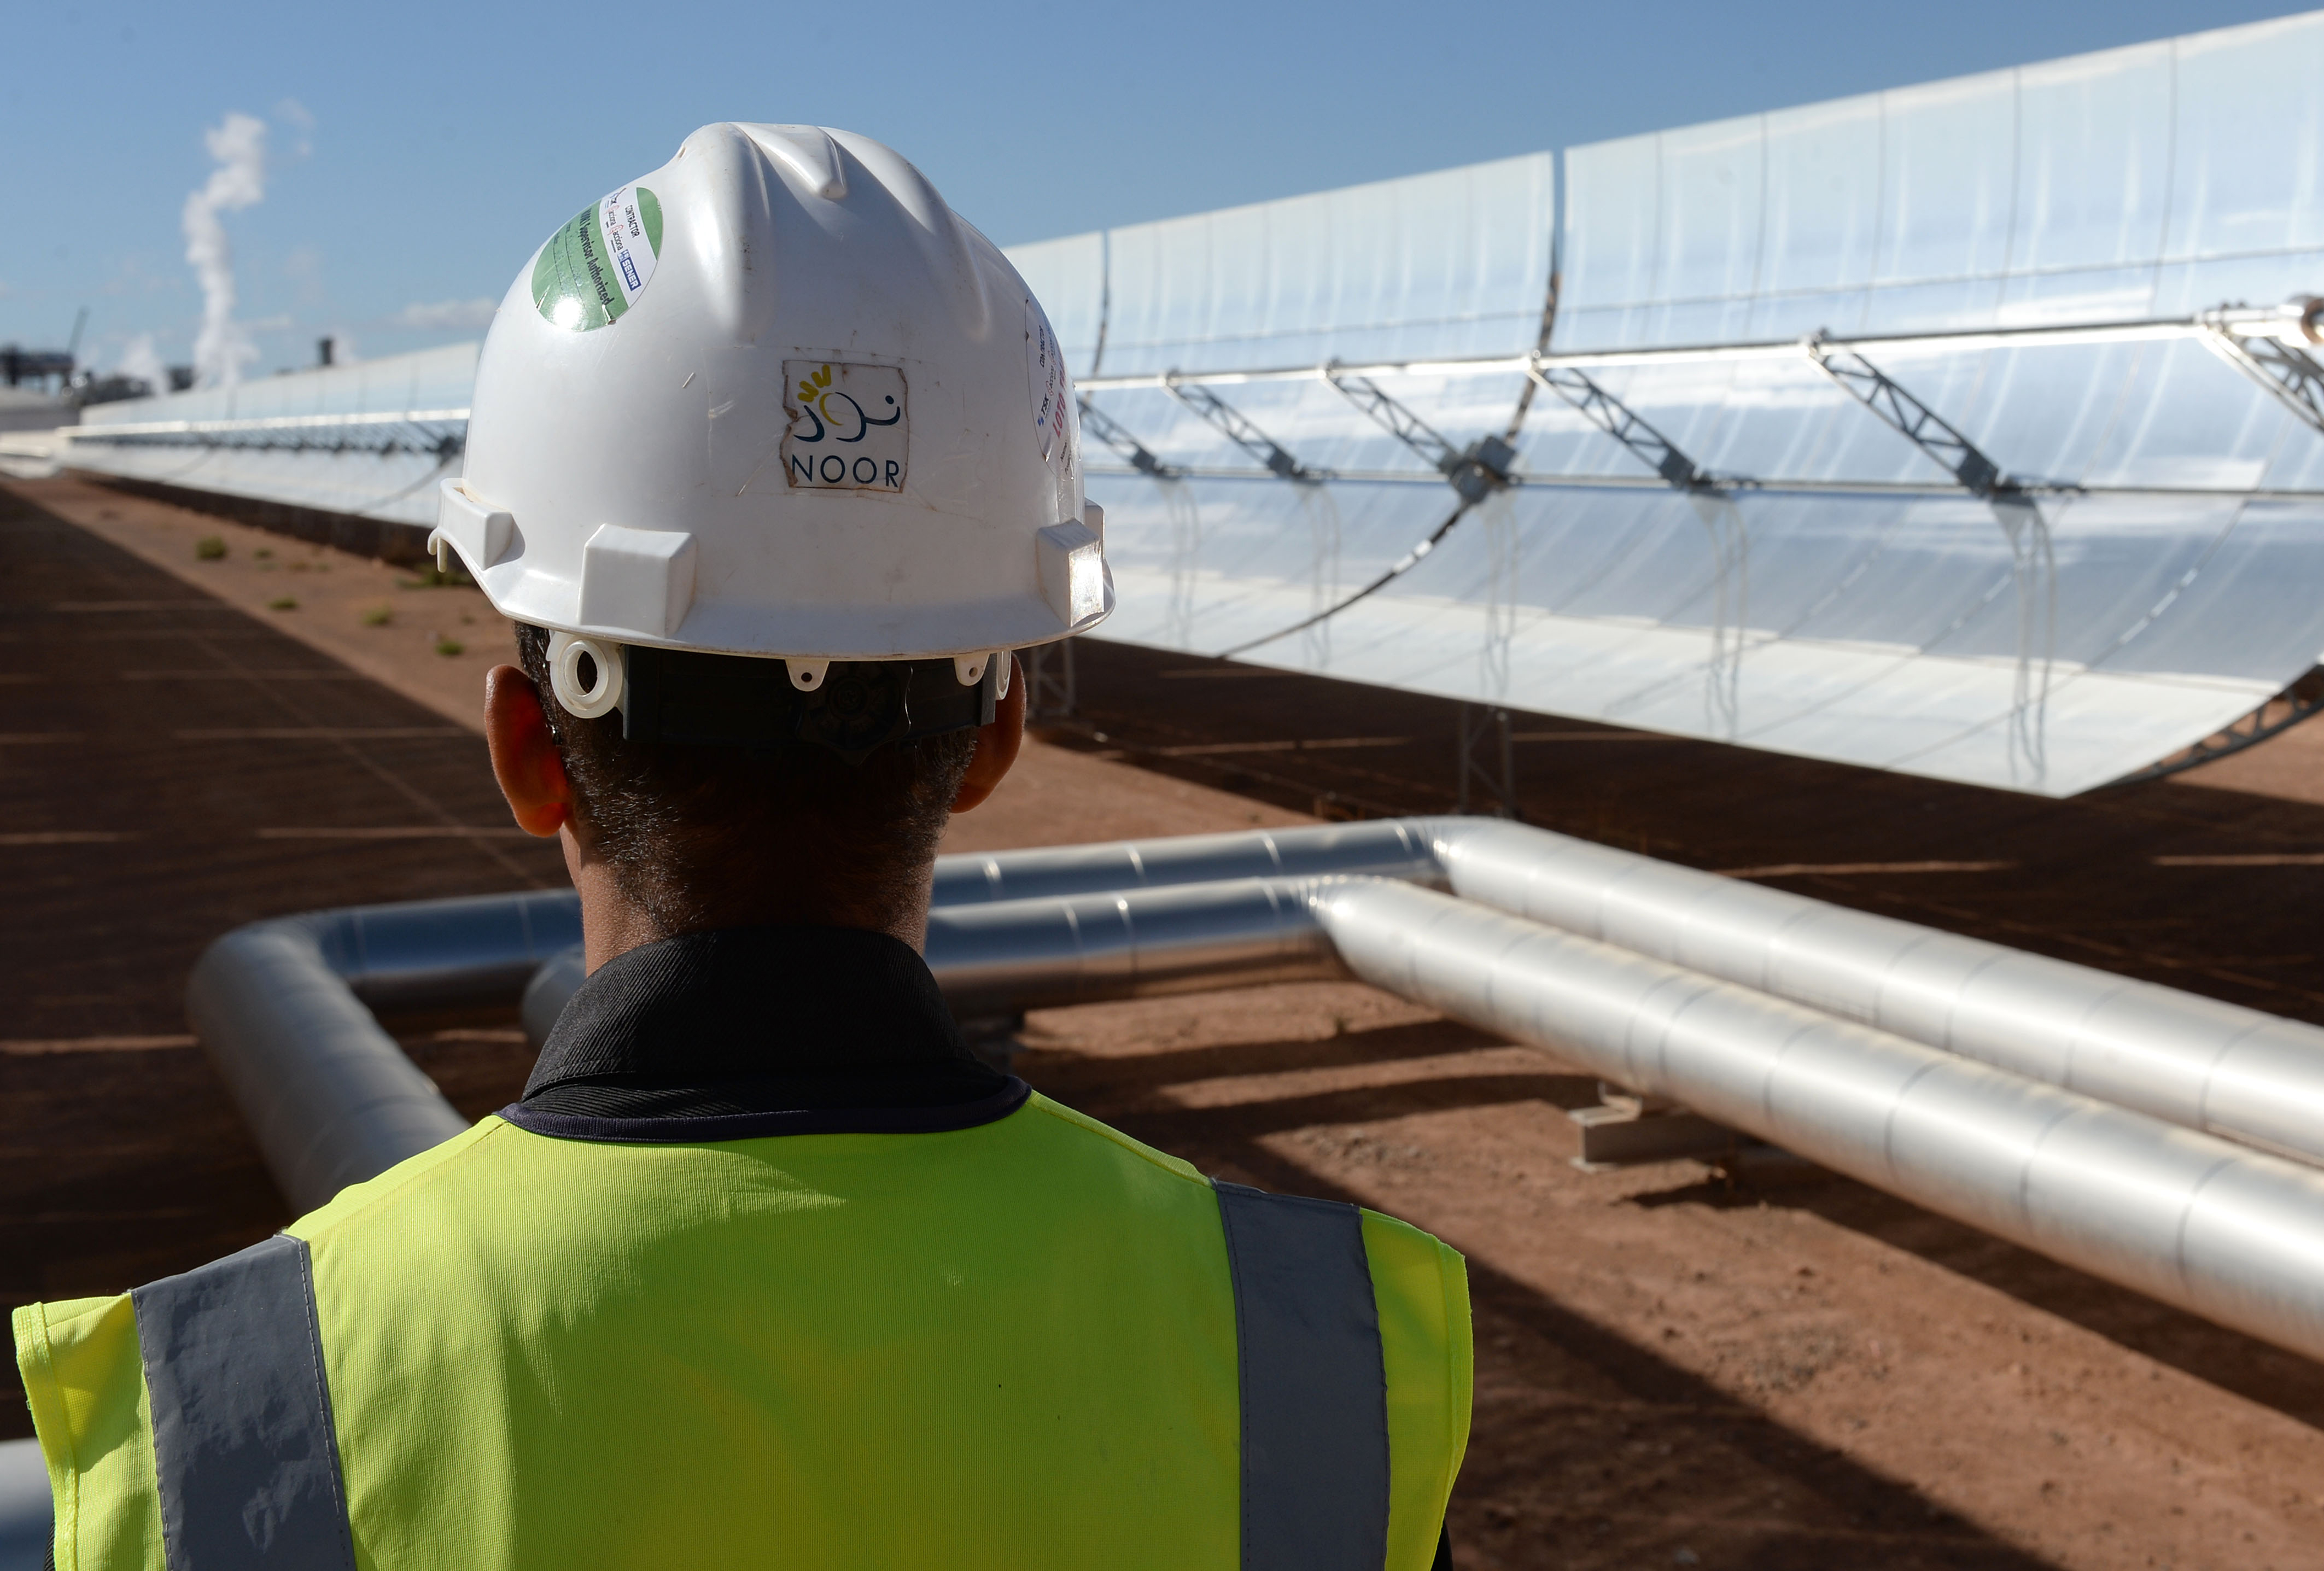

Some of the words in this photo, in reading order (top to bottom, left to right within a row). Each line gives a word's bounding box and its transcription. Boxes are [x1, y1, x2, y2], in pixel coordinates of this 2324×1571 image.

[624, 205, 640, 238] CONTRACTOR
[577, 222, 595, 260] Supervisor
[587, 257, 615, 306] Authorized
[622, 261, 638, 289] SENER
[1041, 393, 1049, 416] TSK
[1052, 392, 1066, 439] LOTO
[792, 453, 900, 488] NOOR
